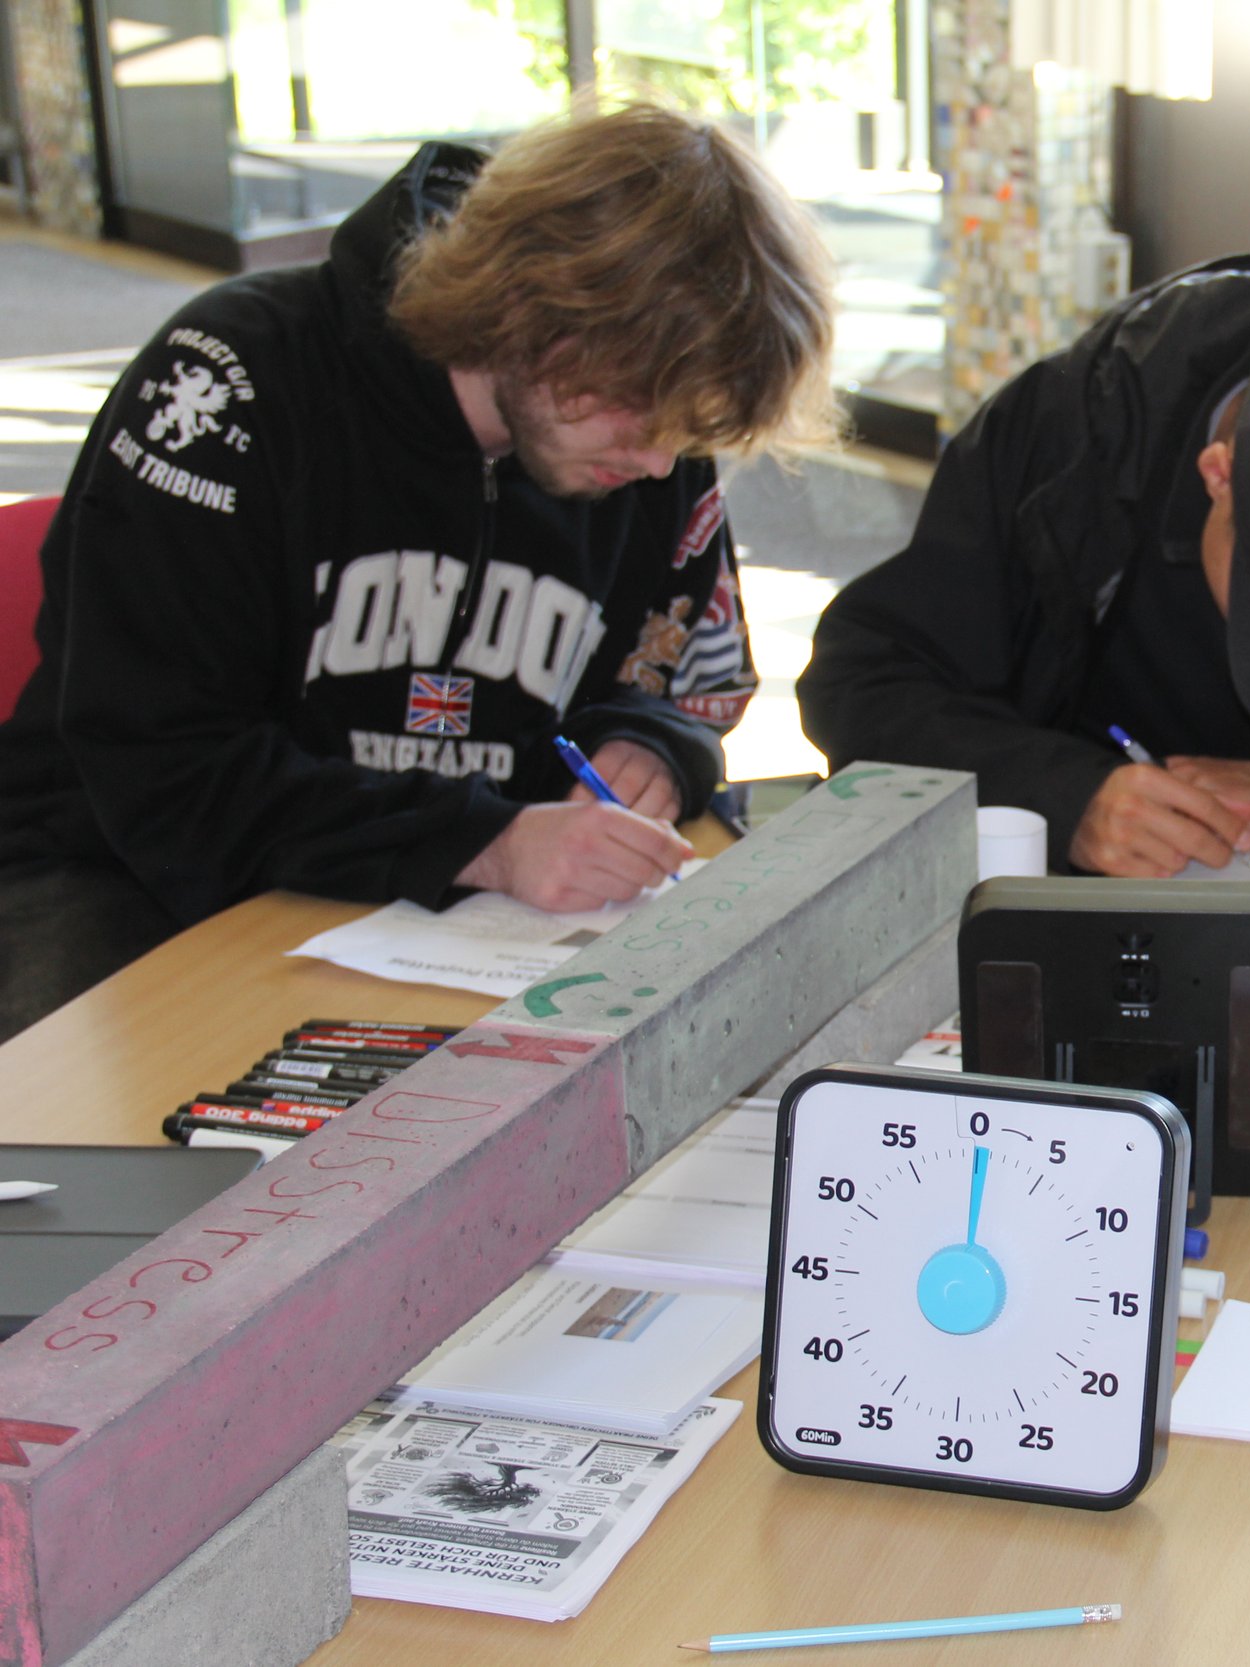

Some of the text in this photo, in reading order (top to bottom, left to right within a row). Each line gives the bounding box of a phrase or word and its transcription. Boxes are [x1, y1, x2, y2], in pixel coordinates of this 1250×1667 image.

[167, 327, 239, 366] PROJECT
[224, 423, 251, 453] FC
[109, 427, 237, 514] EAST TRIBUNE
[272, 1091, 349, 1107] permanent marker
[205, 1105, 307, 1128] edding 300
[970, 1111, 990, 1136] 0
[881, 1124, 917, 1149] 55
[1049, 1140, 1067, 1164] 5
[818, 1176, 855, 1202] 50
[1095, 1207, 1128, 1233] 10
[791, 1255, 829, 1281] 45
[1109, 1291, 1139, 1317] 15
[803, 1337, 843, 1363] 40
[1080, 1371, 1119, 1397] 20
[858, 1405, 893, 1430] 35
[800, 1430, 836, 1445] 60Min
[936, 1436, 973, 1462] 30
[1018, 1425, 1054, 1450] 25
[373, 1536, 438, 1550] SELBST
[440, 1545, 481, 1557] DICH
[391, 1548, 472, 1565] STÄRKEN
[472, 1558, 526, 1573] DEINE
[485, 1552, 521, 1565] FÜR
[523, 1556, 561, 1569] UND
[406, 1559, 544, 1585] KERNHAFTE
